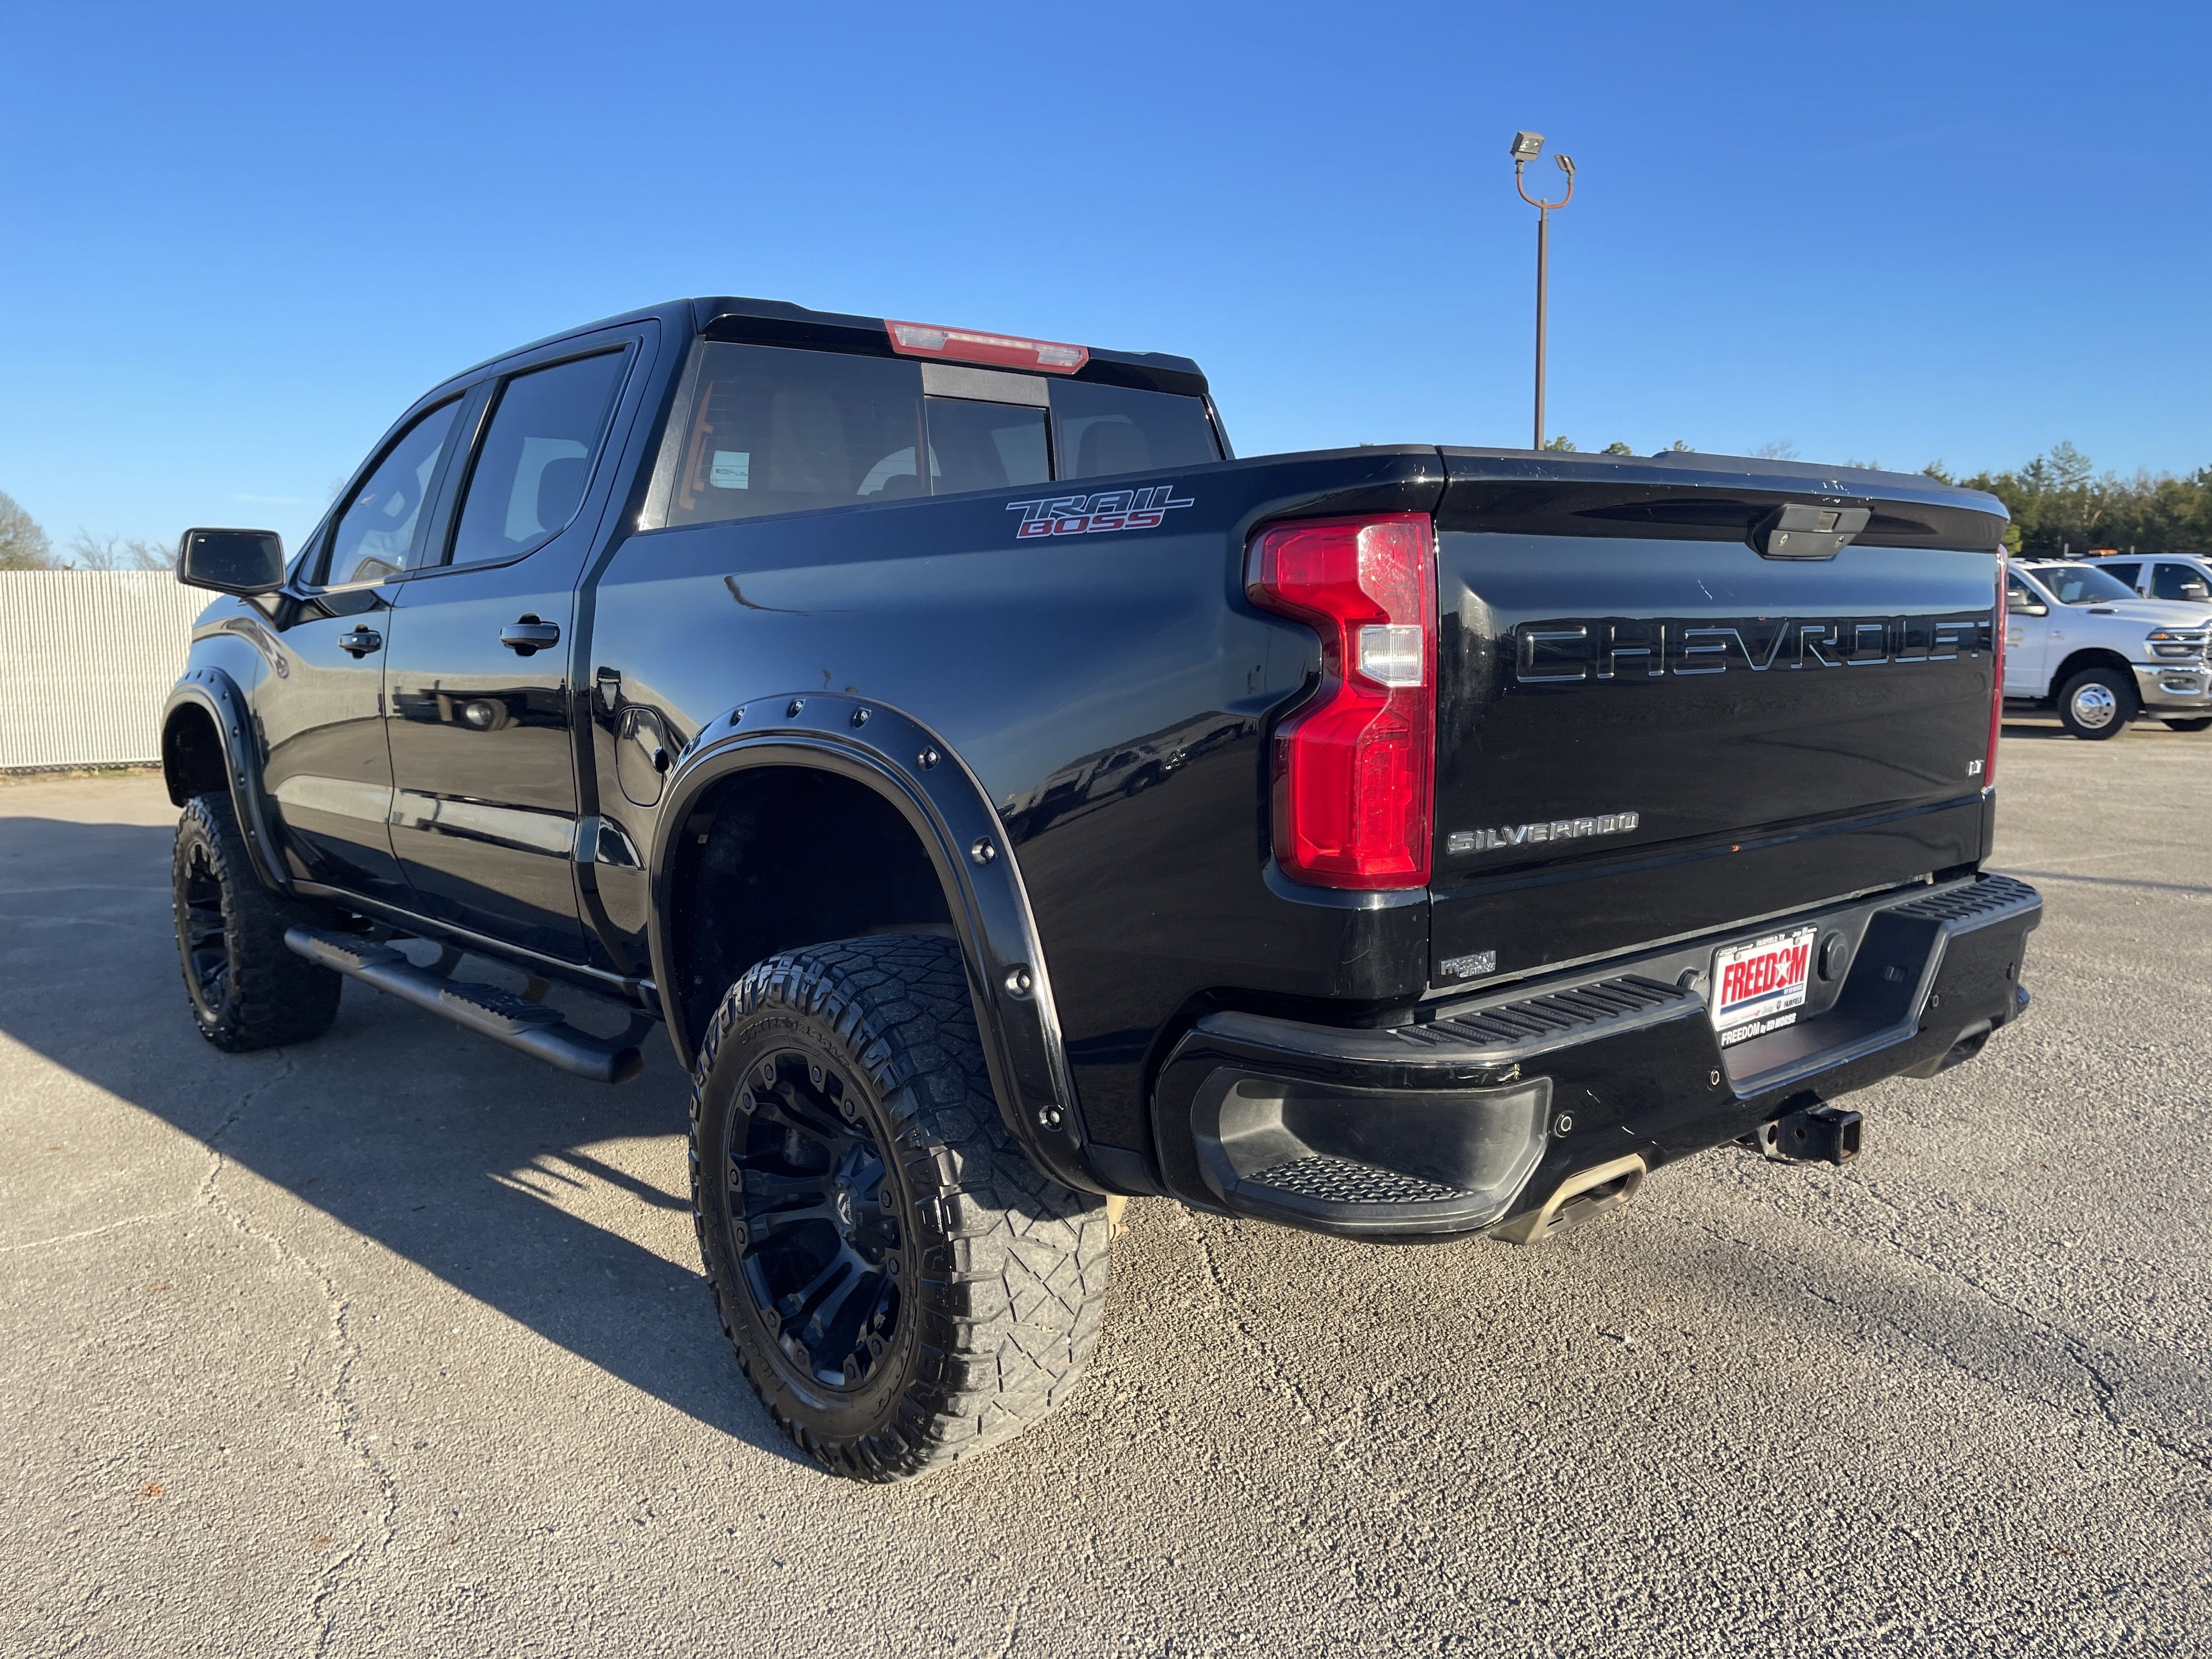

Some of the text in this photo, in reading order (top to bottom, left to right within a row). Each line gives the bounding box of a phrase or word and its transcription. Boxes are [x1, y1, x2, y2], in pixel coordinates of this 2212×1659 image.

[1006, 485, 1195, 521] TRAIL
[1016, 508, 1166, 539] BOSS
[1515, 619, 1991, 684] CHEVROLET
[1447, 811, 1640, 854] SILVERADO
[1721, 944, 1809, 1006] FREEDOM
[1721, 1021, 1760, 1046] FREEDOM
[1766, 1019, 1775, 1031] ED
[1774, 1013, 1797, 1029] MORSE
